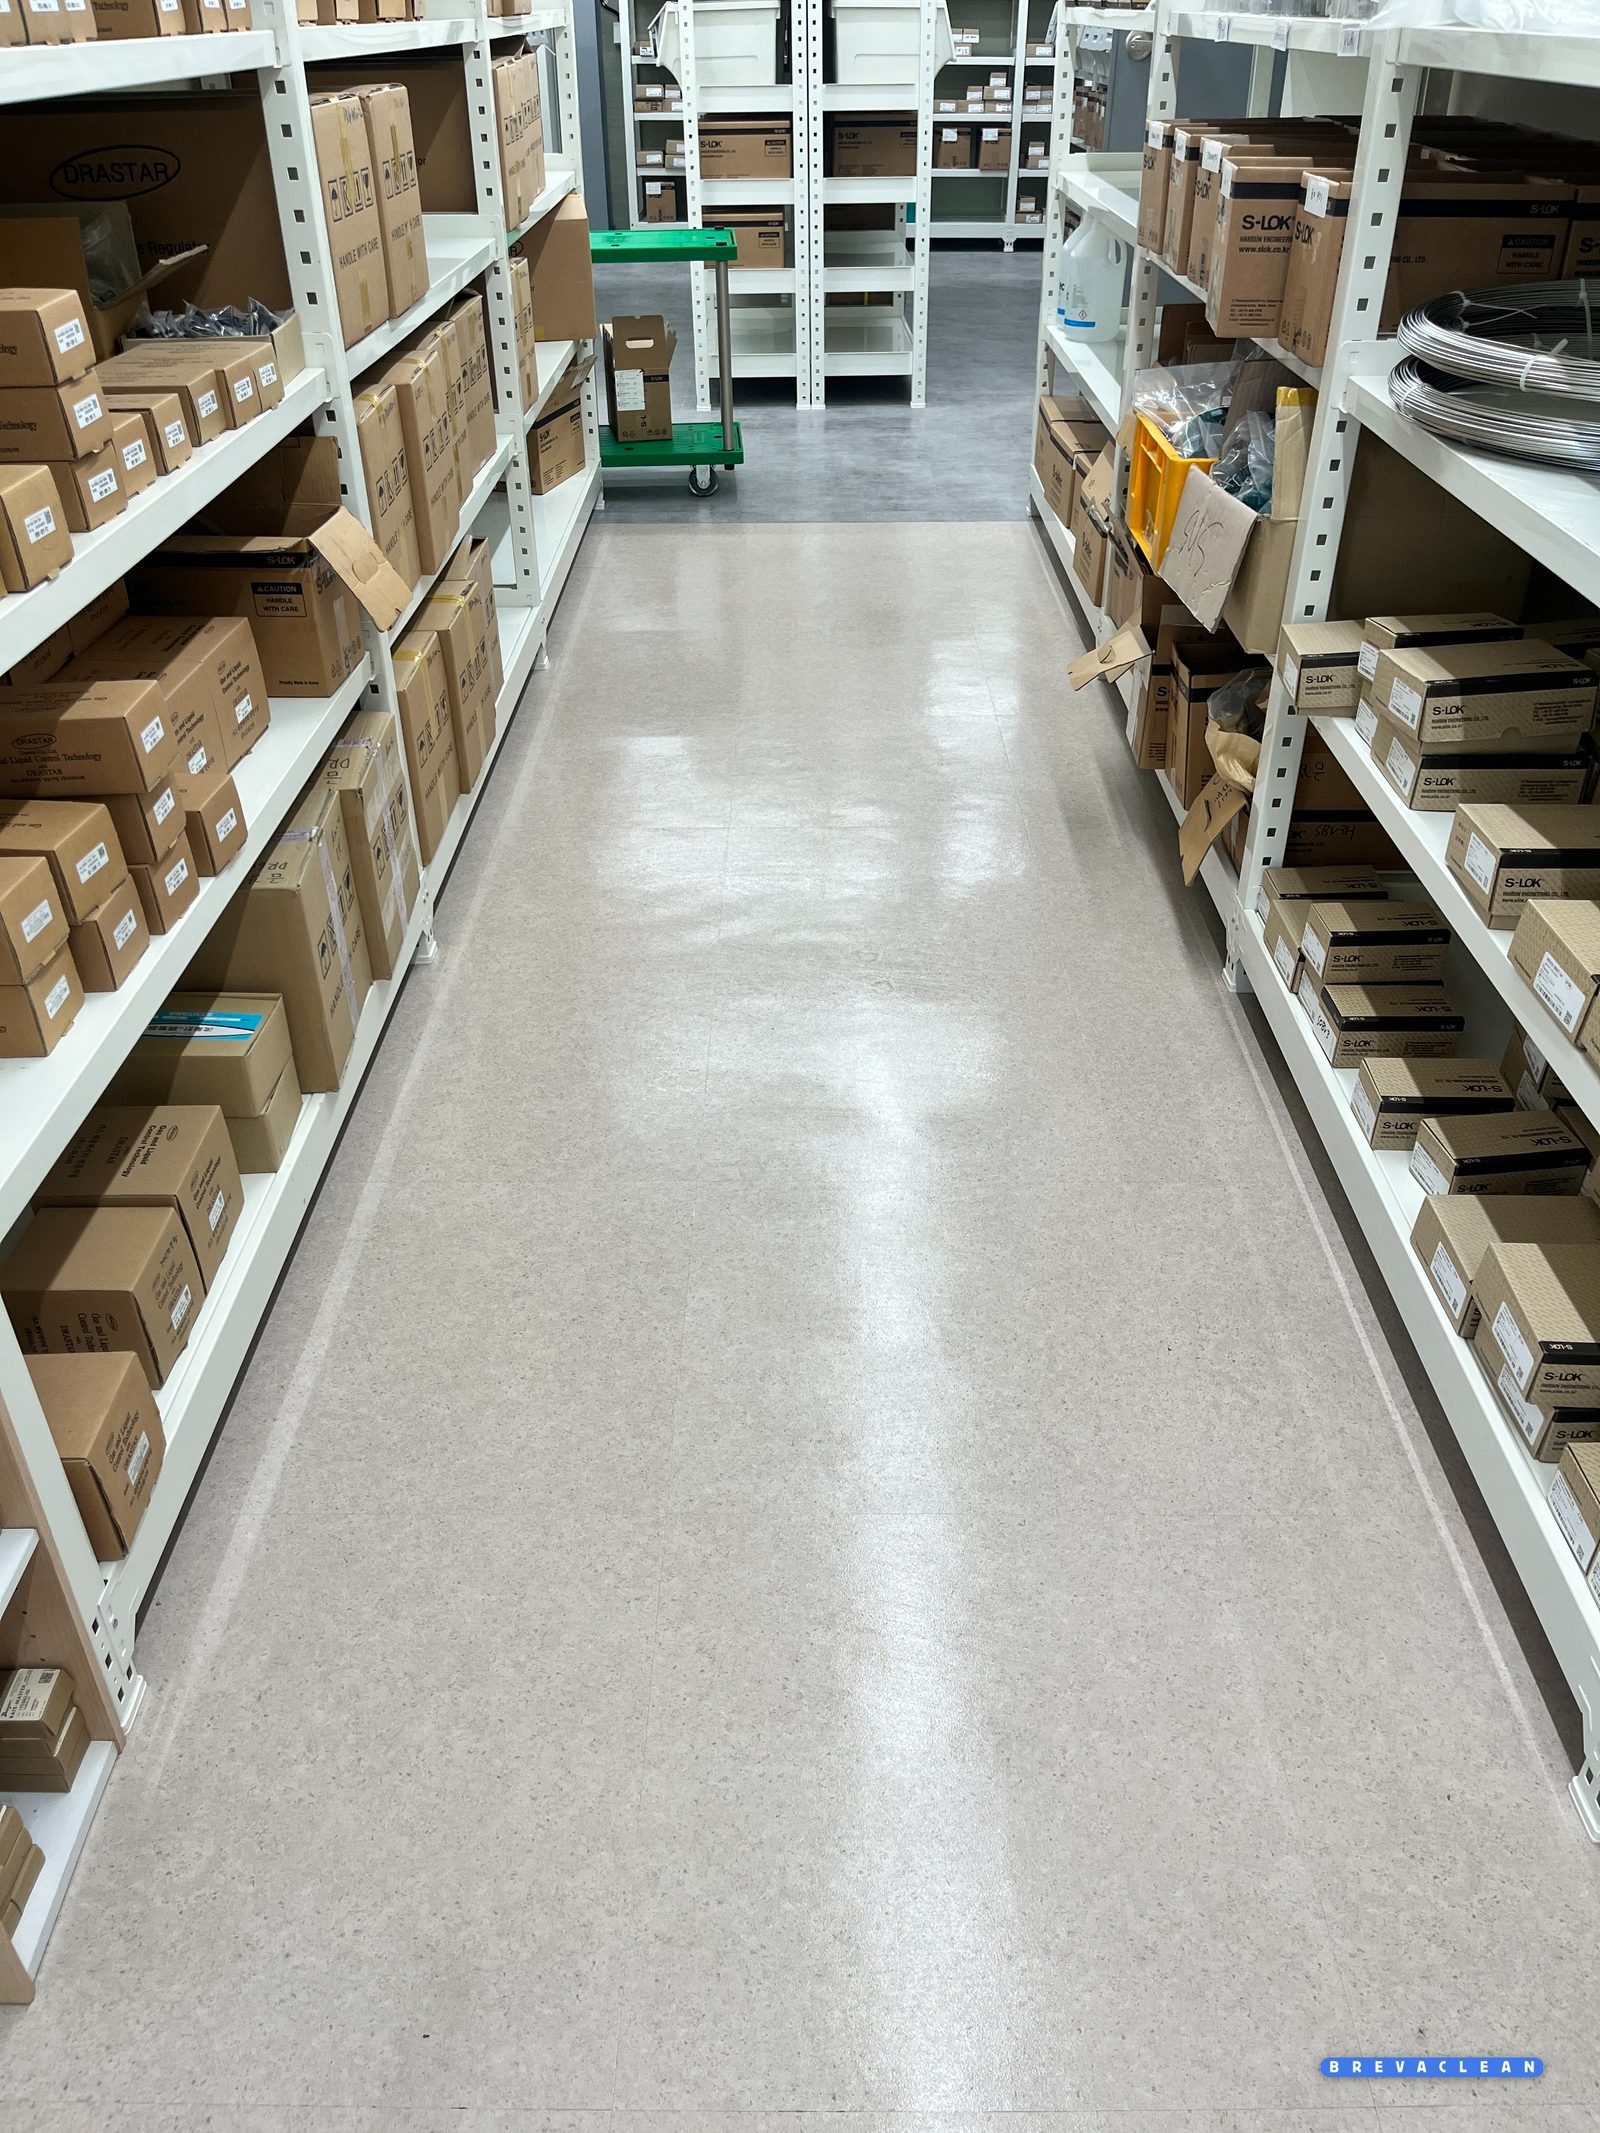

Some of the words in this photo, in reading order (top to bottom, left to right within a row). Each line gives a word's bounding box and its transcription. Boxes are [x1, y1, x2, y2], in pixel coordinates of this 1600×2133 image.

[63, 162, 169, 184] DRASTAR
[1530, 204, 1560, 214] S-LOK
[1242, 215, 1292, 230] S-LOK
[1295, 221, 1314, 245] S-LOK
[339, 248, 357, 270] HANDLE
[357, 243, 368, 258] WITH
[368, 236, 380, 252] CARE
[1239, 246, 1290, 254] www.slok.co.kr
[1523, 261, 1542, 269] CARE
[267, 556, 296, 565] S-LOK
[1306, 675, 1333, 684] S-LOK
[1433, 705, 1464, 716] S-LOK
[9, 755, 32, 765] Liquid
[34, 754, 61, 762] Control
[62, 753, 102, 763] Technology
[1424, 777, 1454, 786] S-LOK
[1505, 878, 1541, 888] S-LOK
[1333, 955, 1361, 963] S-LOK
[1464, 1084, 1504, 1092] S-LOK
[1383, 1121, 1414, 1130] S-LOK
[141, 1125, 156, 1149] Control
[1532, 1136, 1572, 1146] S-LOK
[140, 1146, 153, 1165] Liquid
[121, 1145, 143, 1178] Technology
[1457, 1183, 1490, 1192] S-LOK
[1544, 1372, 1583, 1381] S-LOK
[1556, 1430, 1595, 1439] S-LOK
